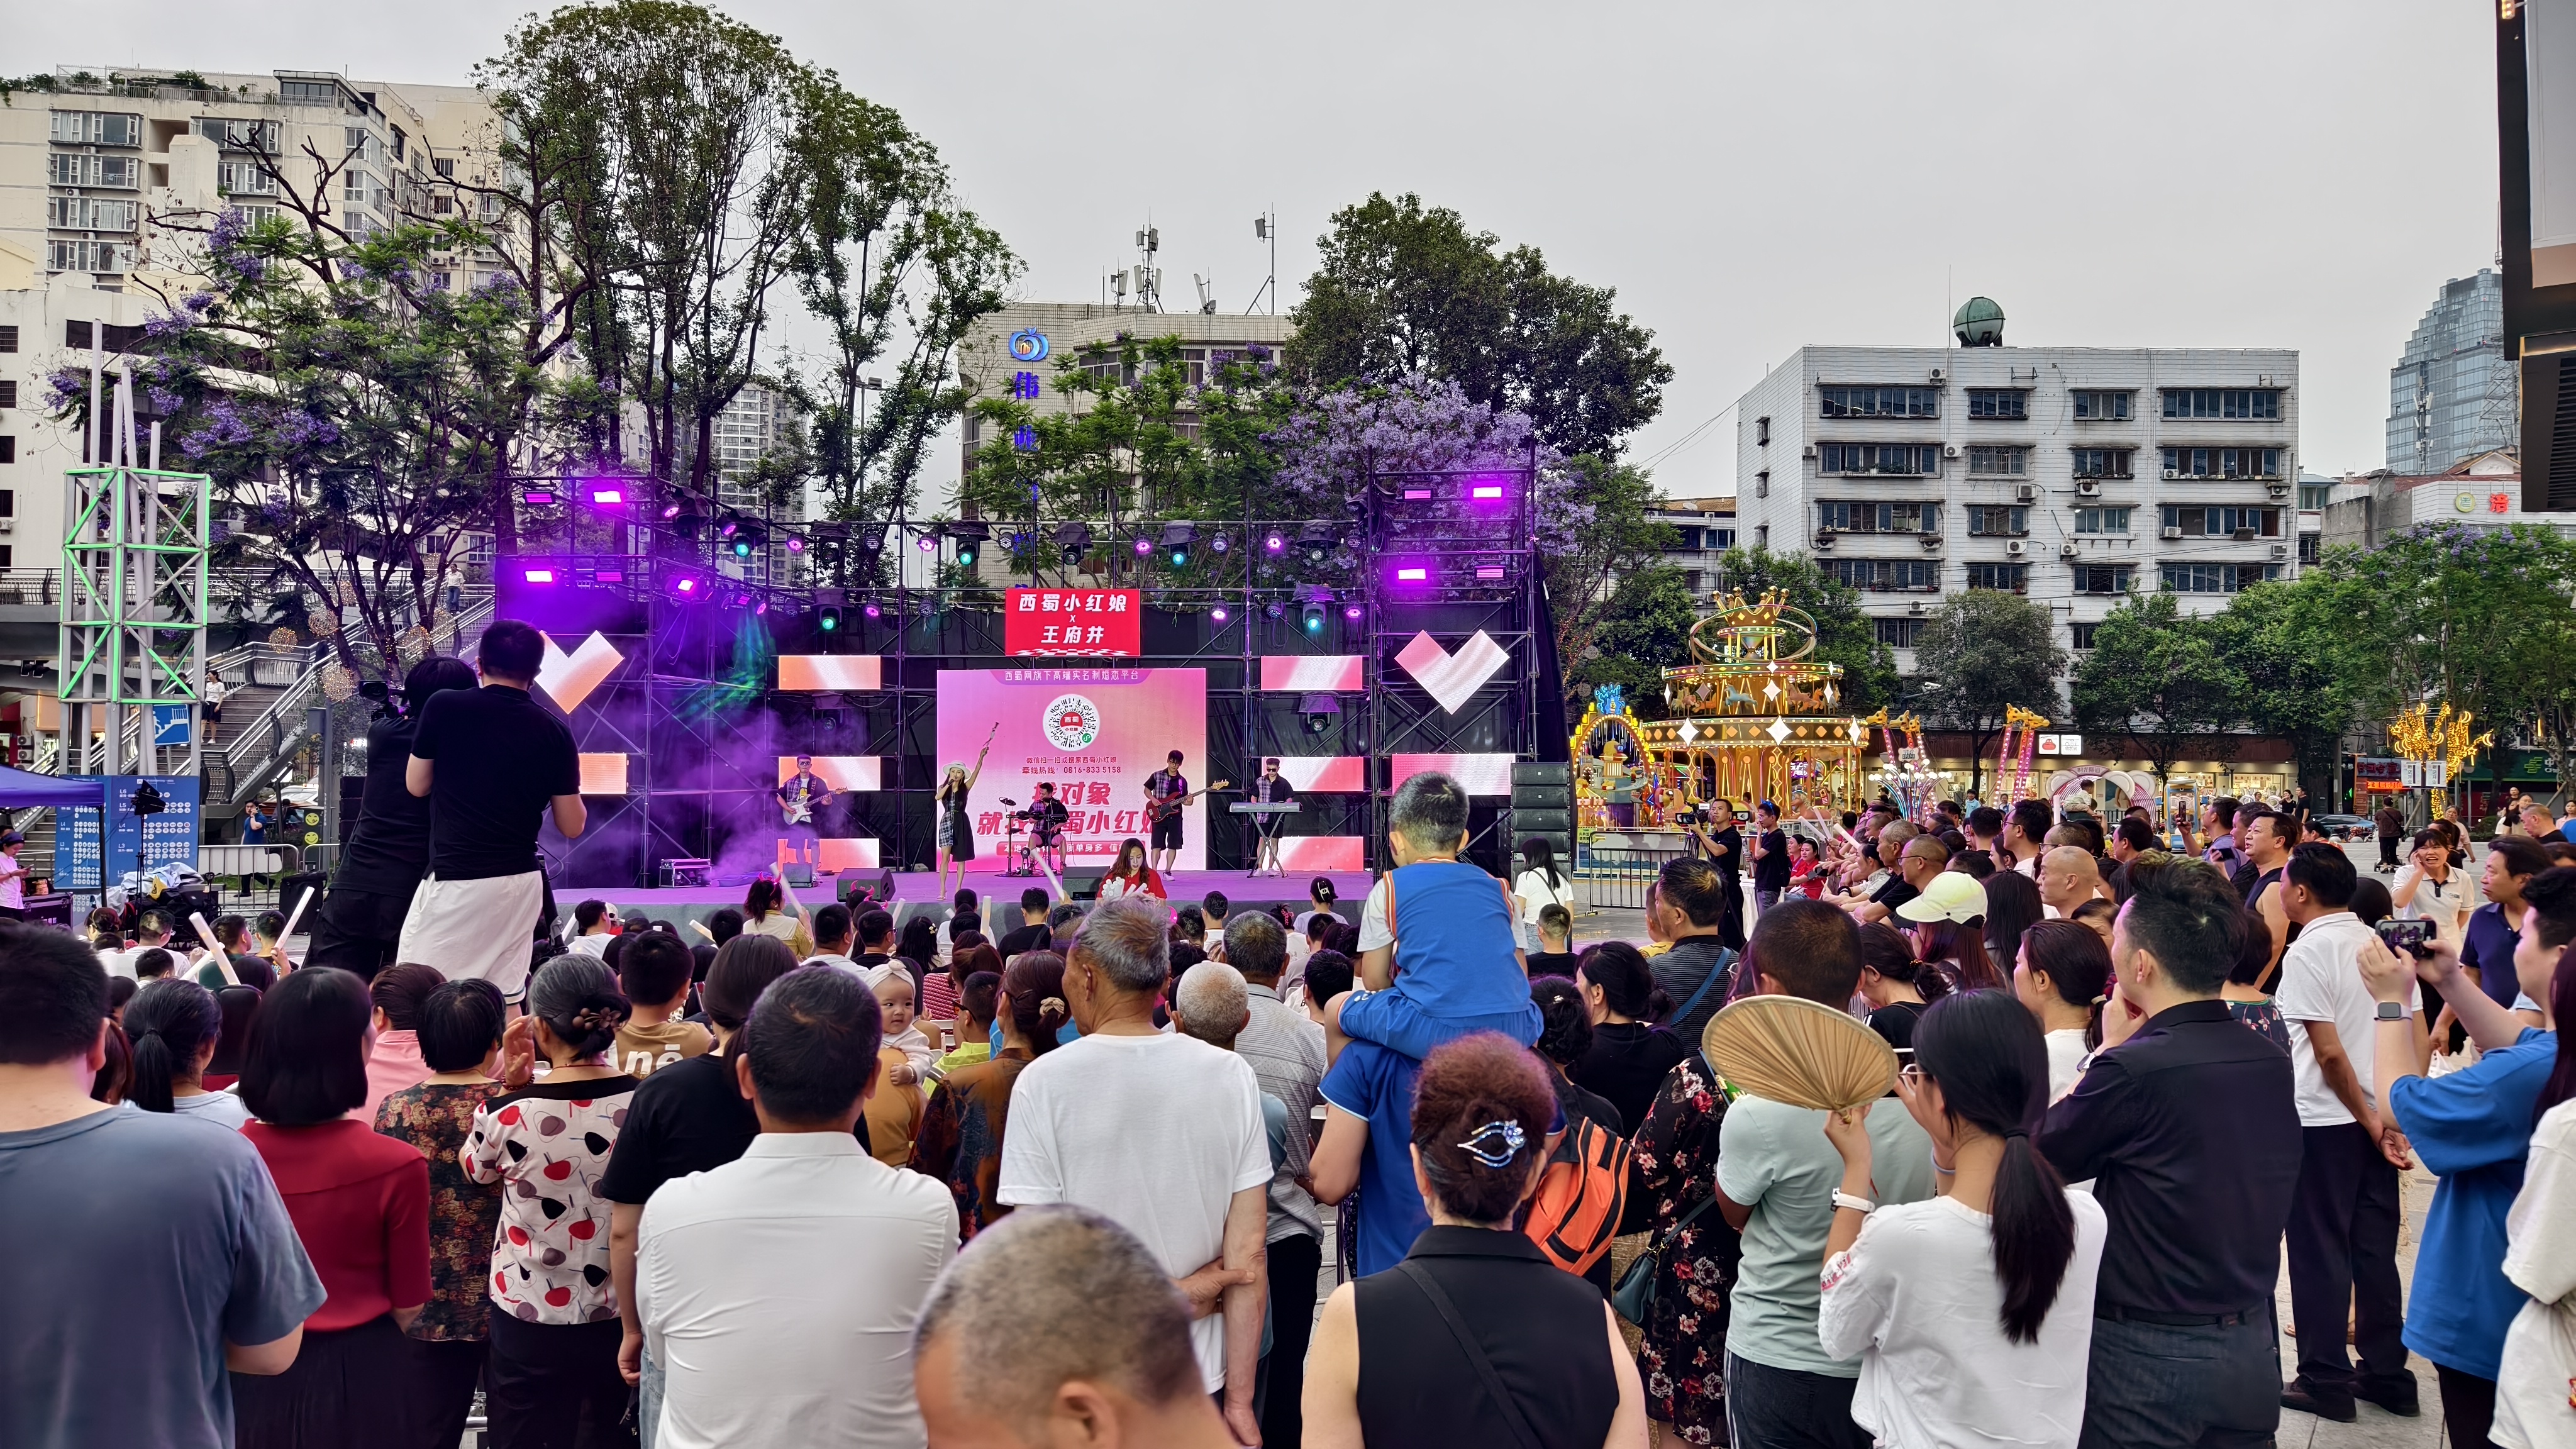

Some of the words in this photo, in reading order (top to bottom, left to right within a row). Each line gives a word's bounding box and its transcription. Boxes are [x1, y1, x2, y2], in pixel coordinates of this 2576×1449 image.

[1018, 593, 1127, 612] 西蜀小红娘
[1041, 625, 1104, 644] 王府井
[1004, 670, 1139, 681] 西蜀网旗下高端实名制婚恋平台
